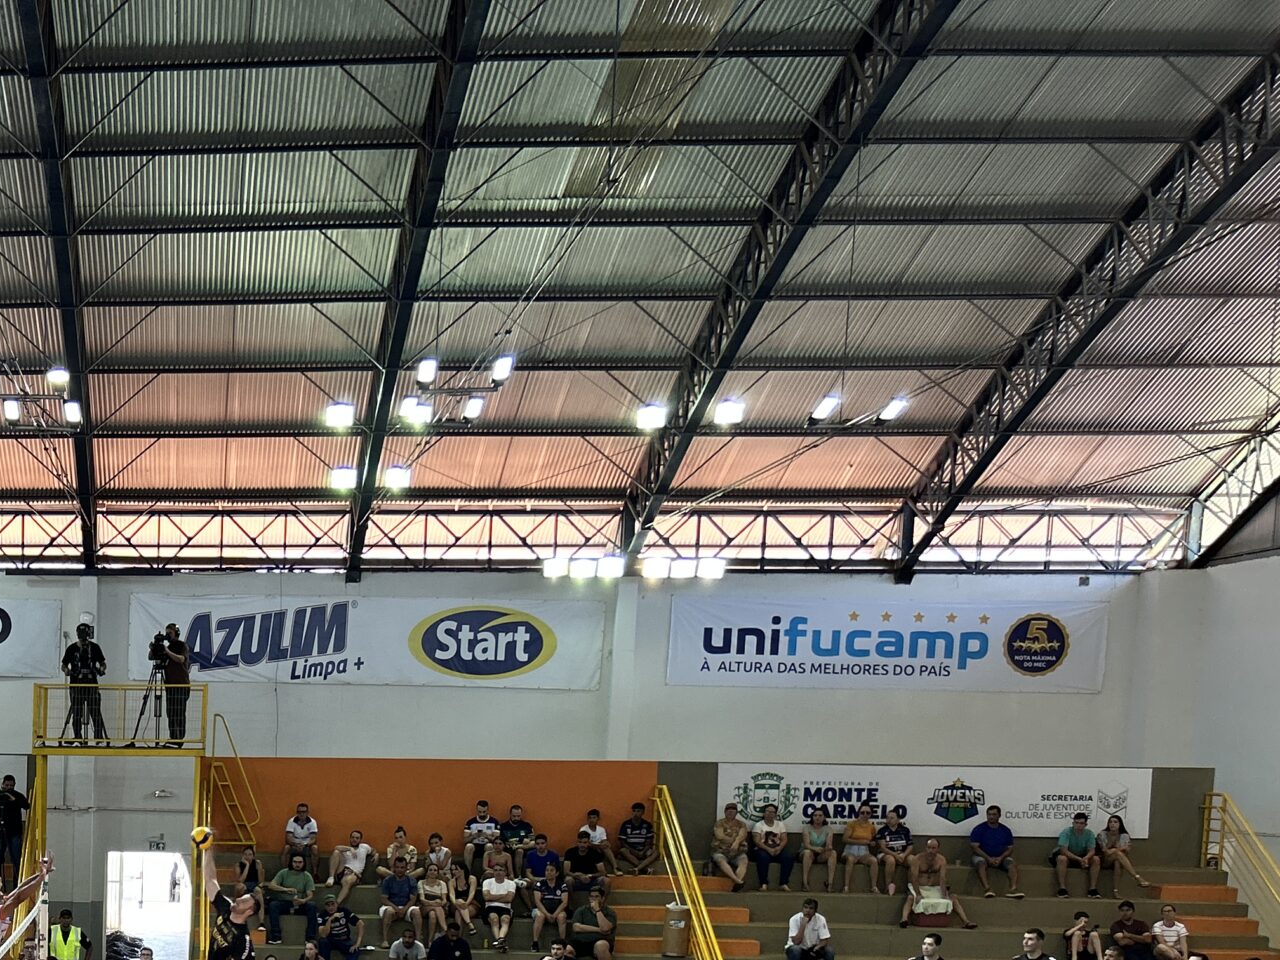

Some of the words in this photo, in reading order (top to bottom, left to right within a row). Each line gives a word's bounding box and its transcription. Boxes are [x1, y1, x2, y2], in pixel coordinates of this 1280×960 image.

[185, 600, 350, 673] AZULIM
[434, 620, 530, 663] Start
[702, 615, 989, 670] unifucamp
[1026, 620, 1049, 645] 5
[290, 657, 348, 680] Limpa
[700, 656, 711, 673] À
[718, 661, 774, 674] ALTURA
[777, 661, 806, 675] DAS
[810, 662, 889, 676] MELHORES
[893, 663, 915, 677] DO
[919, 661, 951, 677] PAÍS
[802, 787, 879, 802] MONTE
[927, 789, 985, 805] JOVENS
[1040, 794, 1094, 802] SECRETARIA
[1005, 811, 1045, 819] CULTURA
[1028, 803, 1040, 811] DE
